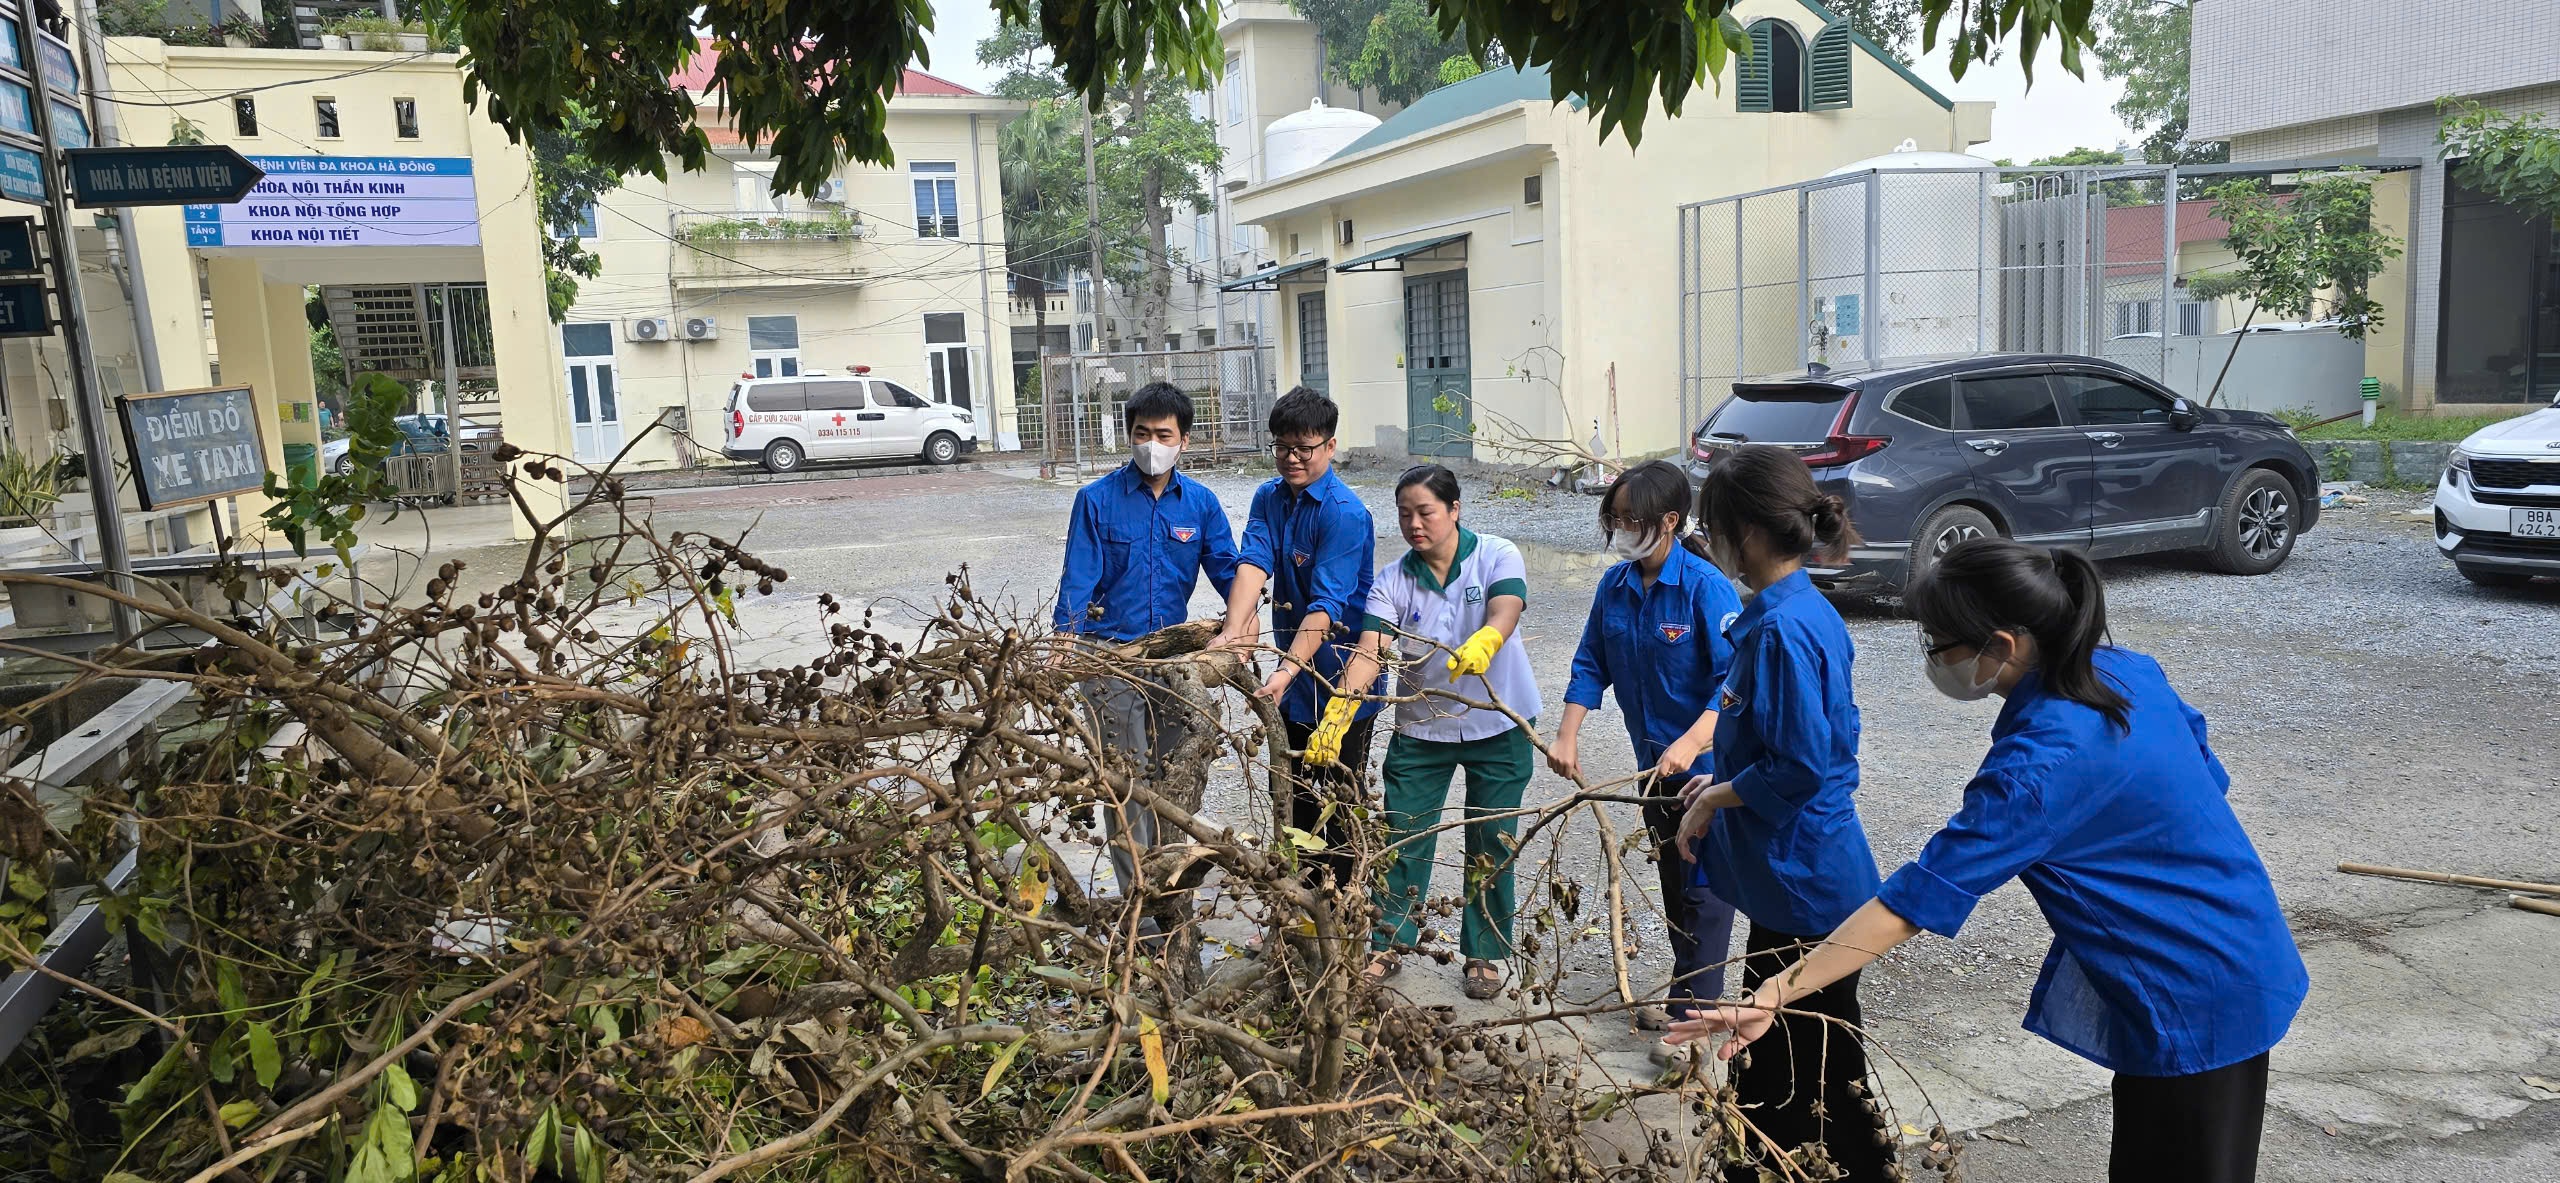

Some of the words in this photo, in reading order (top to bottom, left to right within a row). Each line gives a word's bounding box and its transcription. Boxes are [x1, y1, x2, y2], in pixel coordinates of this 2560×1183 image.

[287, 159, 316, 172] VIỆN
[319, 161, 337, 171] ĐA
[340, 161, 376, 171] KHOA
[379, 160, 397, 171] HÀ
[399, 161, 436, 172] ĐÔNG
[89, 164, 125, 191] NHÀ
[127, 164, 149, 190] ĂN
[151, 163, 195, 193] BỆNH
[195, 162, 233, 192] VIỆN
[292, 180, 320, 195] NỘI
[368, 182, 405, 194] KINH
[199, 211, 206, 219] 2
[248, 205, 290, 217] KHOA
[295, 203, 322, 219] NỘI
[326, 202, 367, 217] TỔNG
[371, 205, 401, 220] HỢP
[202, 235, 208, 243] 1
[251, 229, 293, 241] KHOA
[298, 227, 325, 243] NỘI
[329, 226, 360, 241] TIẾT
[145, 399, 205, 442] ĐIỂM
[208, 395, 240, 434] ĐỖ
[779, 414, 802, 422] 24/24H
[818, 429, 834, 437] 0334
[836, 428, 848, 436] 115
[849, 428, 861, 436] 115
[152, 452, 193, 490] XE
[194, 444, 256, 481] TAXI
[2527, 510, 2553, 523] 88A
